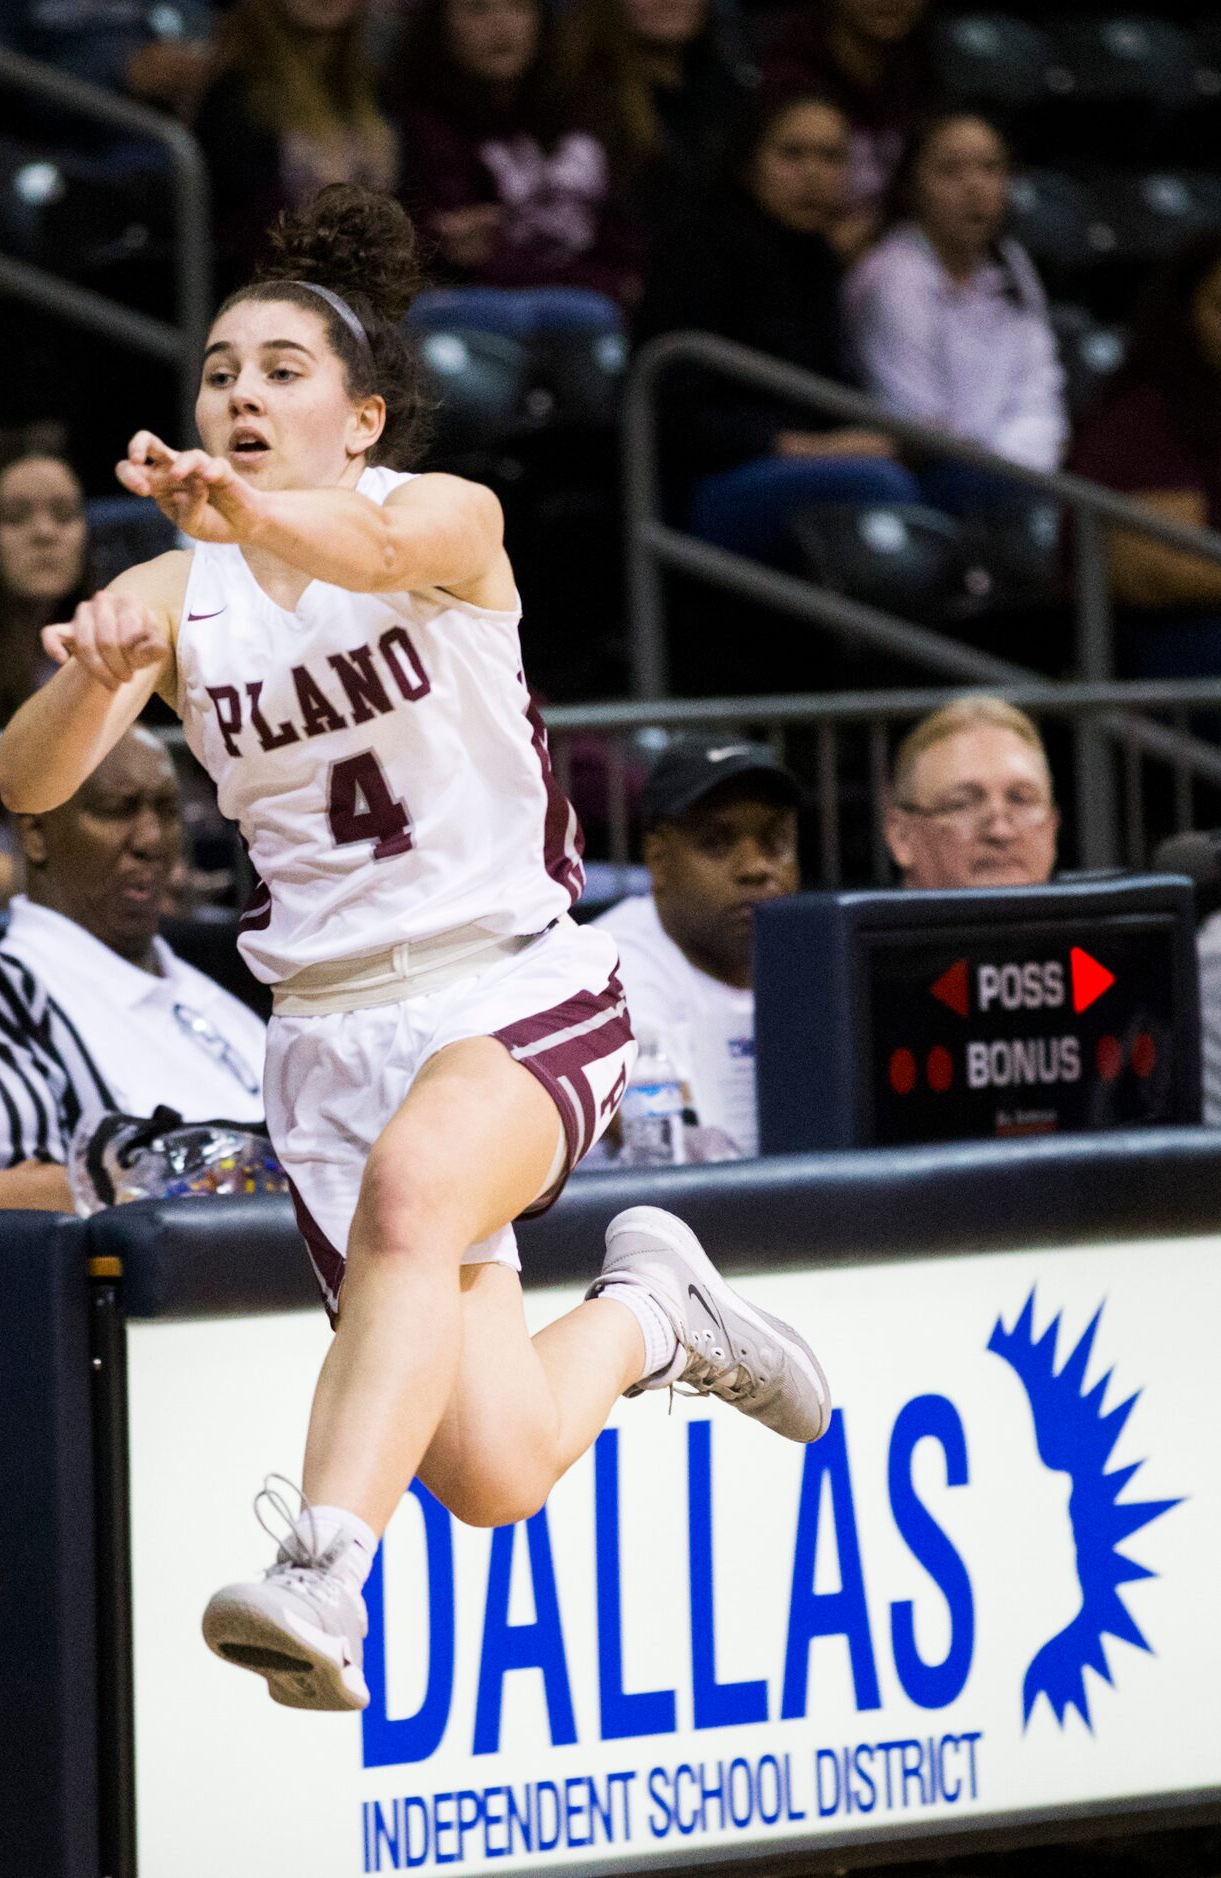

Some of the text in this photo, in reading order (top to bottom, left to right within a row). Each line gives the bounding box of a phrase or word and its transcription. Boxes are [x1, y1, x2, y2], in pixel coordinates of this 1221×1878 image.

[205, 625, 431, 758] PLANO
[325, 746, 416, 865] 4
[978, 961, 1065, 1012] POSS
[966, 1035, 1081, 1089] BONUS
[363, 1393, 977, 1769] DALLAS
[362, 1732, 983, 1874] INDEPENDENT SCHOOL DISTRICT
